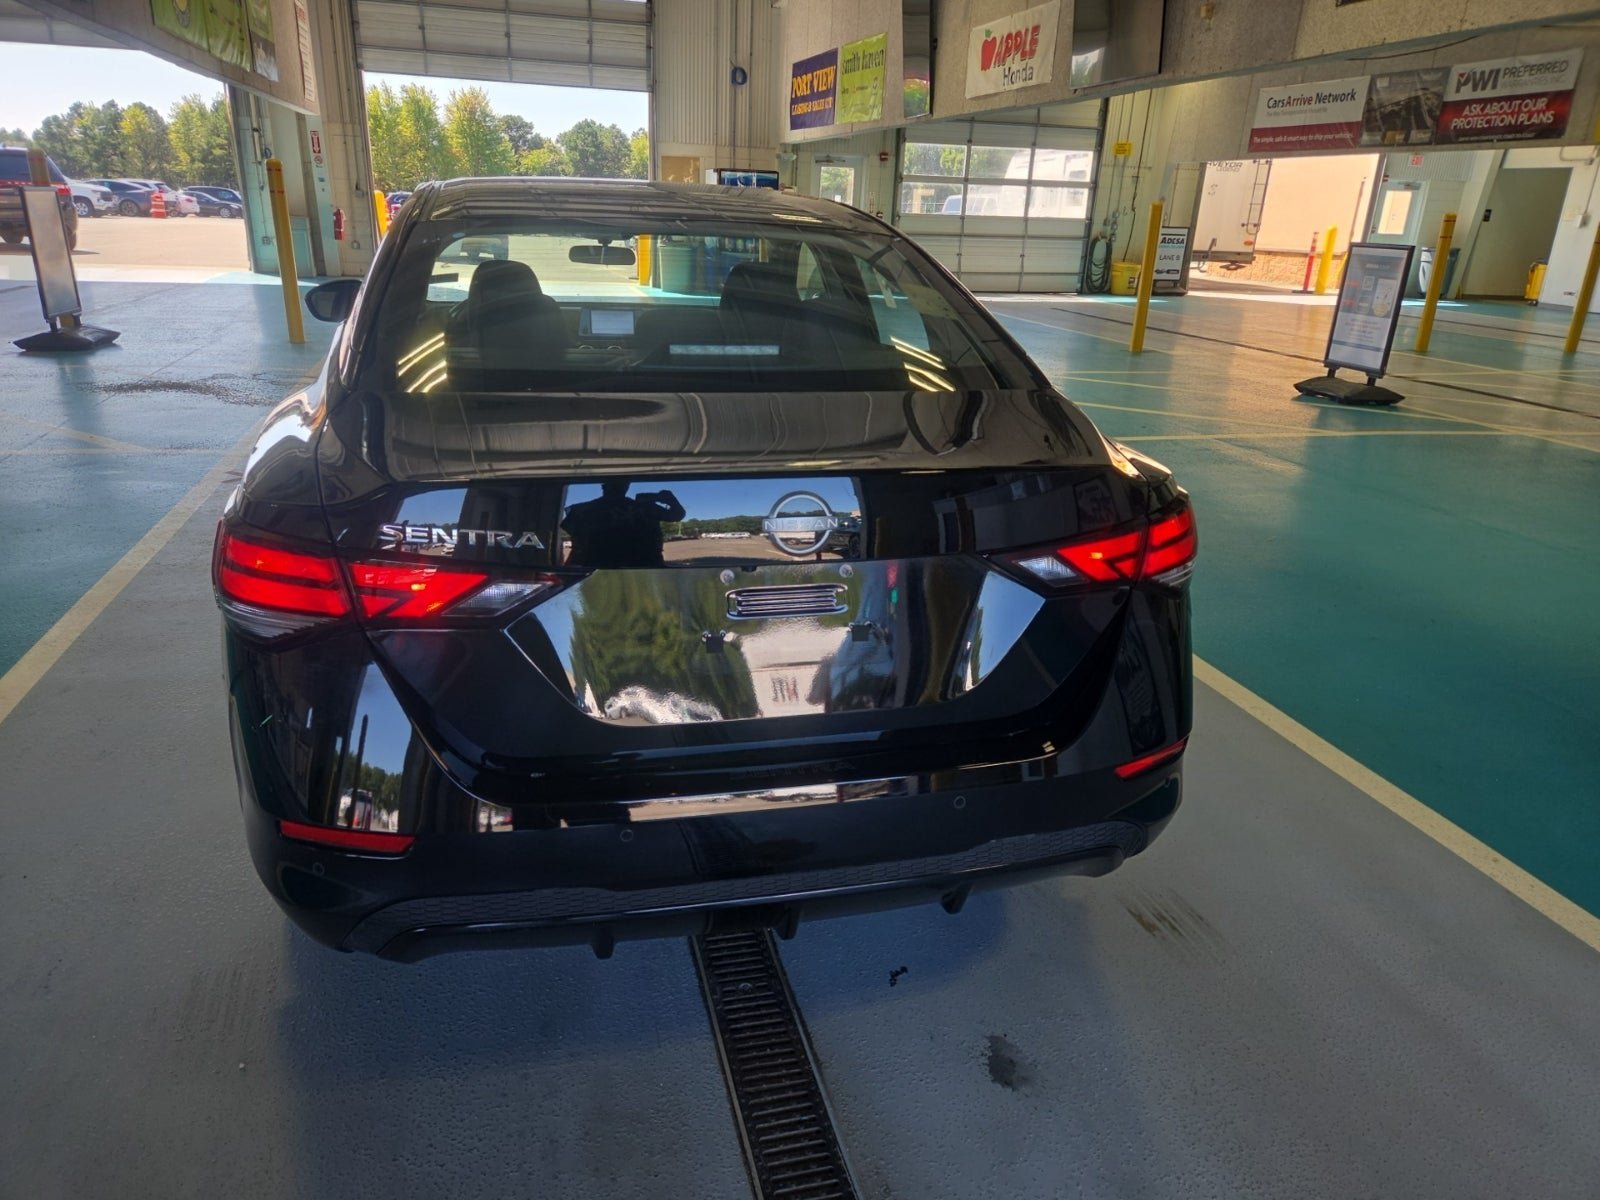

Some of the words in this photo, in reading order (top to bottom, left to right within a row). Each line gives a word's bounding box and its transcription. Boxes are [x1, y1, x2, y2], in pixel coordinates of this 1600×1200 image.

[993, 24, 1041, 68] APPLE
[1003, 62, 1034, 86] Honda
[1455, 68, 1501, 94] PWI
[1502, 60, 1569, 79] PREFERRED
[792, 73, 813, 99] PORT
[813, 65, 836, 93] VIEW
[1266, 94, 1313, 109] CarsArrive
[1314, 88, 1357, 104] Network
[1462, 103, 1485, 117] ASK
[1484, 99, 1522, 115] ABOUT
[1521, 97, 1548, 112] OUR
[1451, 114, 1519, 130] PROTECTION
[1517, 110, 1555, 125] PLANS
[379, 524, 545, 549] SENTRA
